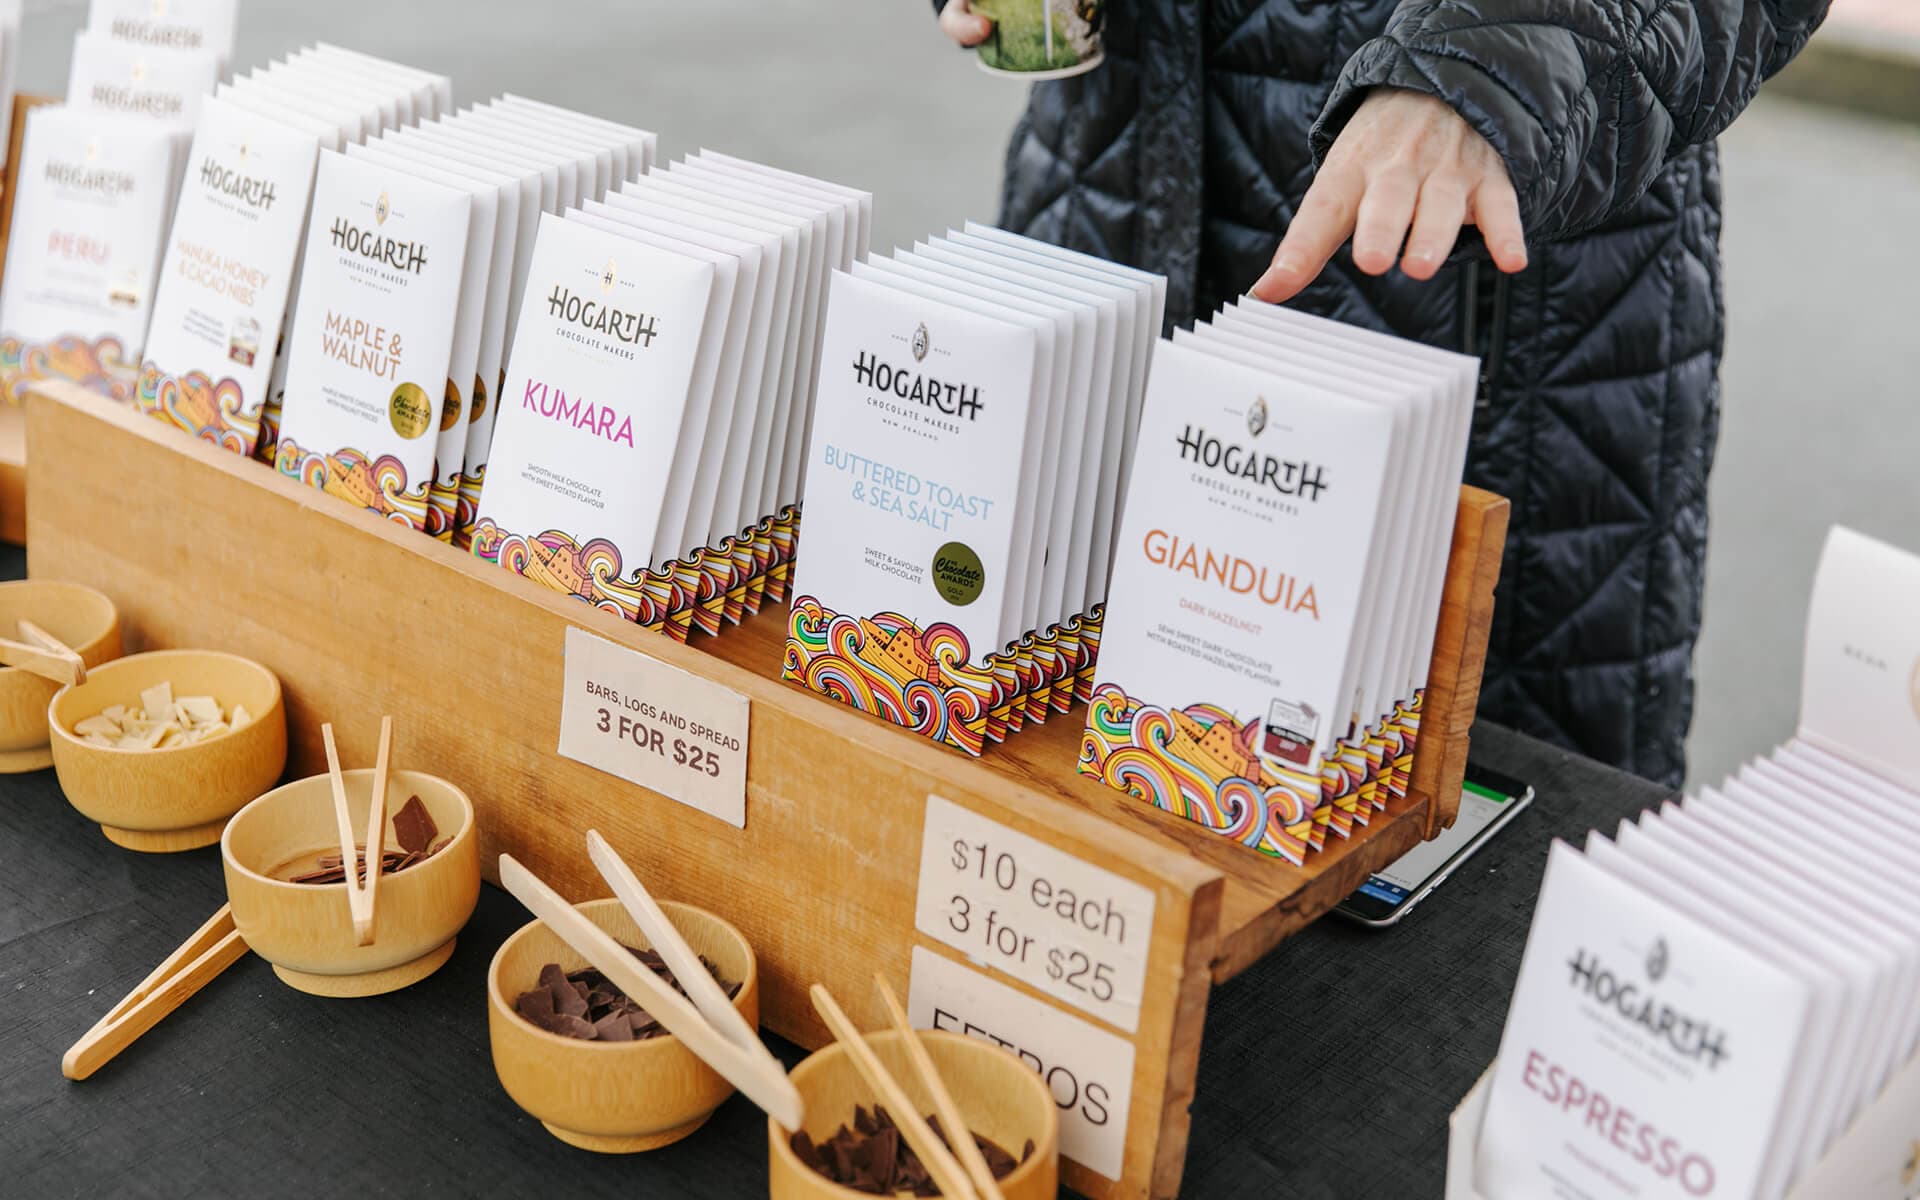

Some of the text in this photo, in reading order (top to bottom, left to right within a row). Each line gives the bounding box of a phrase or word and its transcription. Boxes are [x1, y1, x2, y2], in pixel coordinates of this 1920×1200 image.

[200, 156, 276, 211] HOGARTH
[330, 216, 428, 275] HOGARTH
[222, 255, 271, 290] HONEY
[227, 282, 256, 307] NIBS
[339, 257, 408, 288] CHOCOLATE MAKERS
[324, 308, 403, 357] MAPLE &
[548, 285, 658, 348] HOGARTH
[322, 333, 401, 382] WALNUT
[556, 327, 601, 350] CHOCOLATE
[604, 344, 636, 361] MAKERS
[853, 351, 984, 421] HOGARTH
[523, 378, 634, 449] KUMARA
[867, 397, 960, 435] CHOCOLATE MAKERS
[882, 418, 939, 441] NEW ZEALAND
[552, 473, 565, 483] MILK
[566, 478, 602, 498] CHOCOLATE
[824, 444, 994, 520] BUTTERED TOAST
[1176, 424, 1328, 502] HOGARTH
[536, 477, 554, 489] SWEET
[554, 484, 577, 499] POTATO
[577, 493, 605, 509] FLAVOUR
[852, 480, 953, 532] & SEA SALT
[1191, 472, 1299, 516] CHOCOLATE MAKERS
[865, 547, 887, 561] SWEET
[893, 558, 925, 575] SAVOURY
[865, 557, 921, 584] MILK CHOCOLATE
[936, 557, 981, 581] Chocolate
[941, 572, 975, 588] AWARDS
[1143, 529, 1320, 621] GIANDUIA
[1179, 597, 1263, 636] DARK HAZELNUT
[1167, 638, 1202, 658] ROASTED
[1202, 654, 1243, 673] HAZELNUT
[1244, 668, 1281, 688] FLAVOUR
[1176, 630, 1202, 646] SWEET
[1202, 640, 1223, 654] DARK
[1224, 648, 1273, 673] CHOCOLATE
[586, 680, 740, 751] BARS, LOGS AND SPREAD
[597, 707, 721, 778] 3 FOR $25
[951, 839, 1127, 946] $10 each
[948, 895, 1115, 1002] 3 for $25
[1567, 948, 1731, 1071] HOGARTH
[933, 1008, 1110, 1126] EOS
[1521, 1047, 1716, 1198] ESPRESSO
